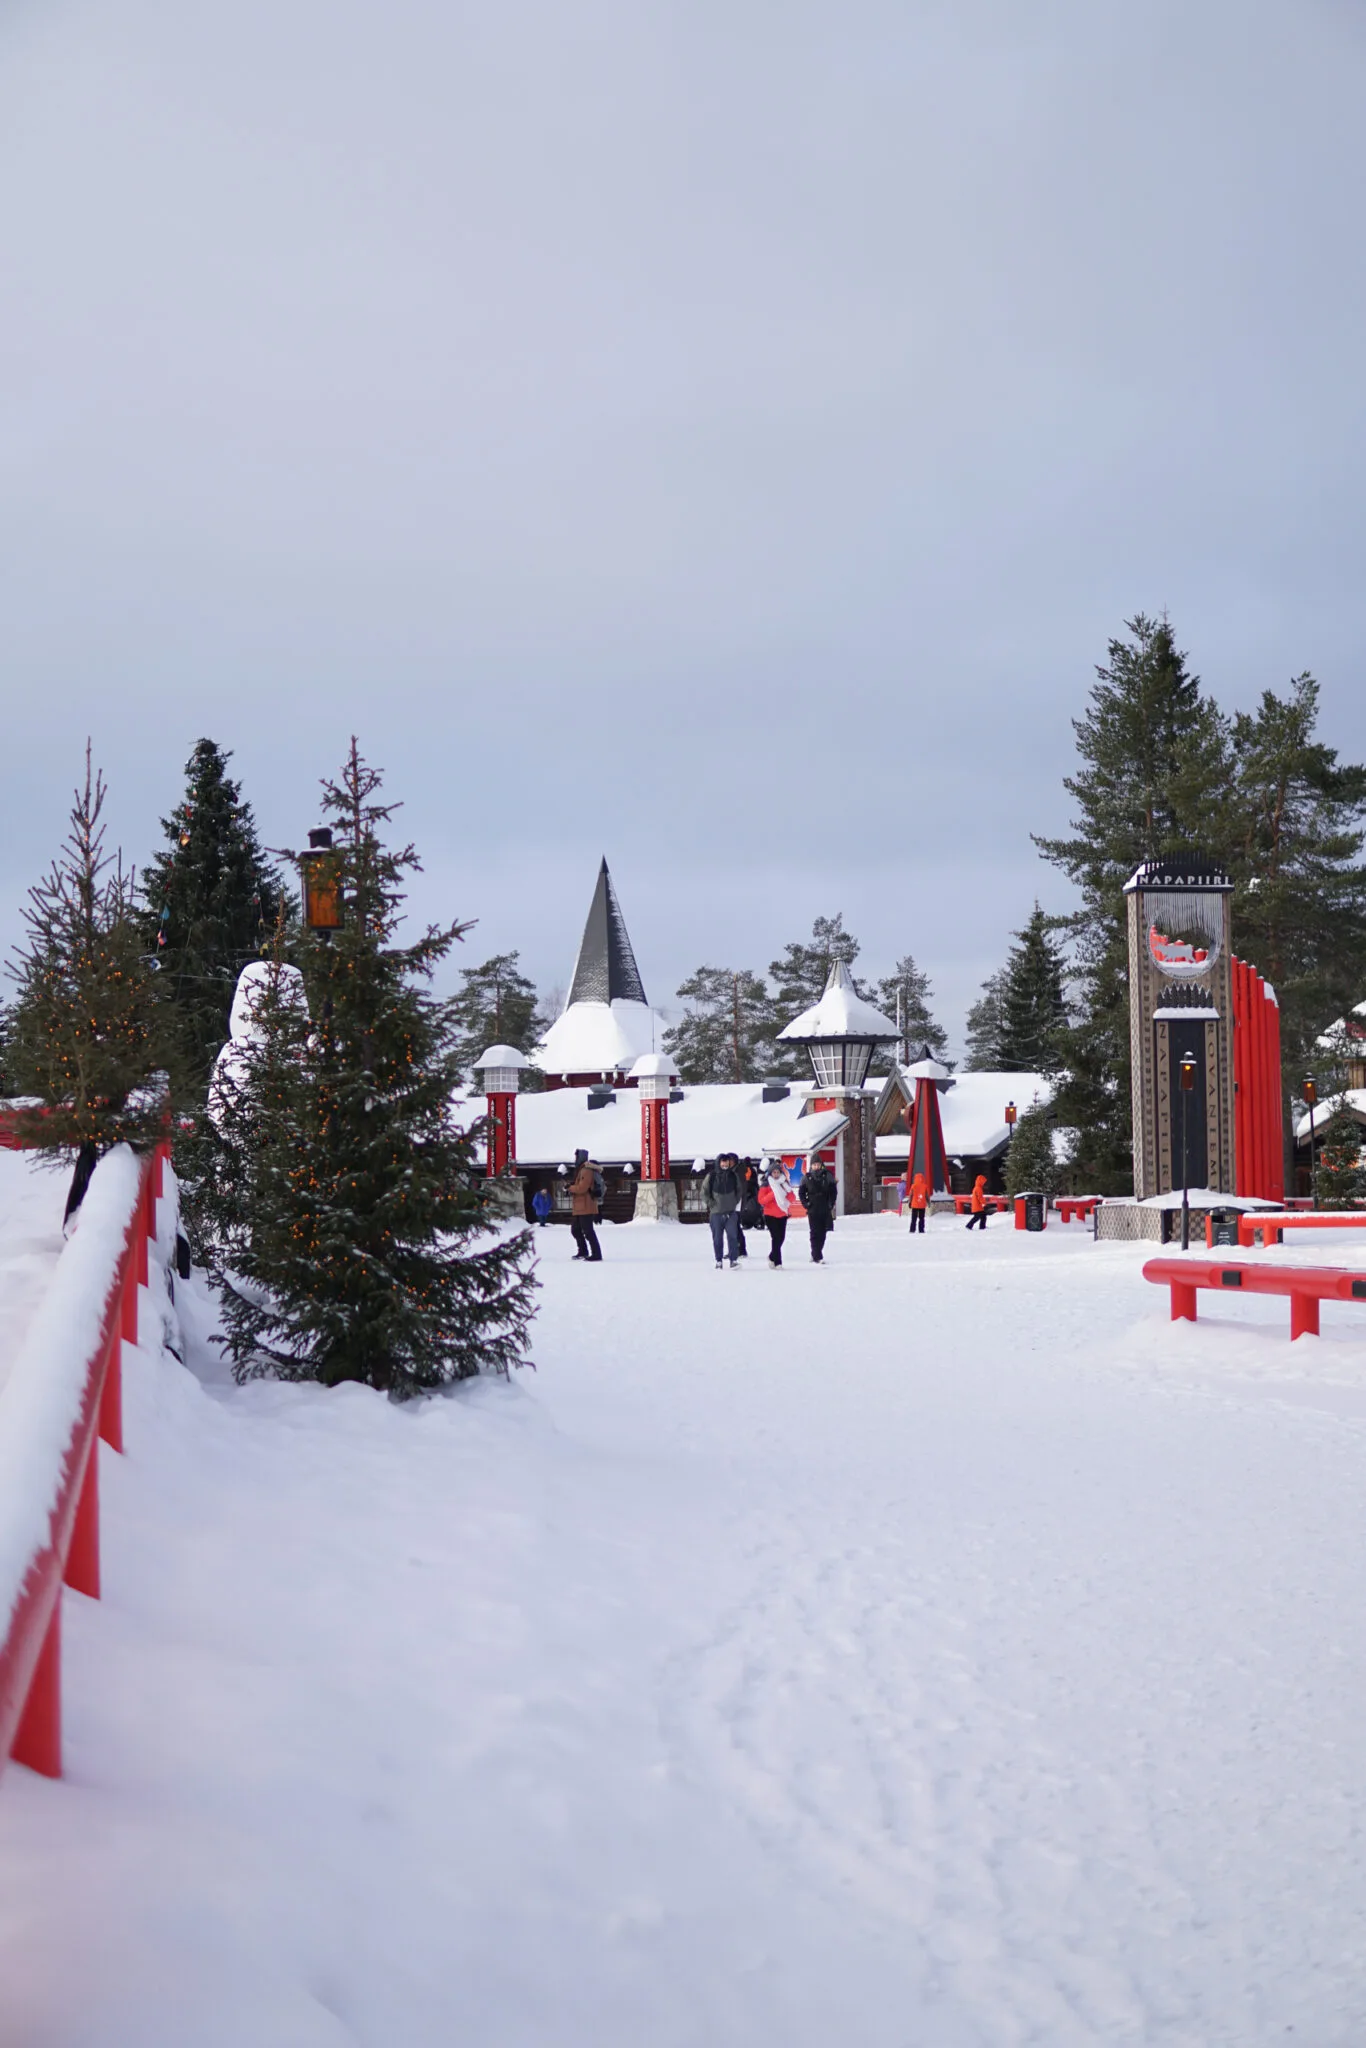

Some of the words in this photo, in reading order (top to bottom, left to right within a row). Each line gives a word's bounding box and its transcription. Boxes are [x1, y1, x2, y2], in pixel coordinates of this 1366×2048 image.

[1140, 875, 1229, 885] NAPAPIIRI
[1160, 1024, 1169, 1190] NAPAPIIRI
[1208, 1023, 1217, 1190] ROVANIEMI
